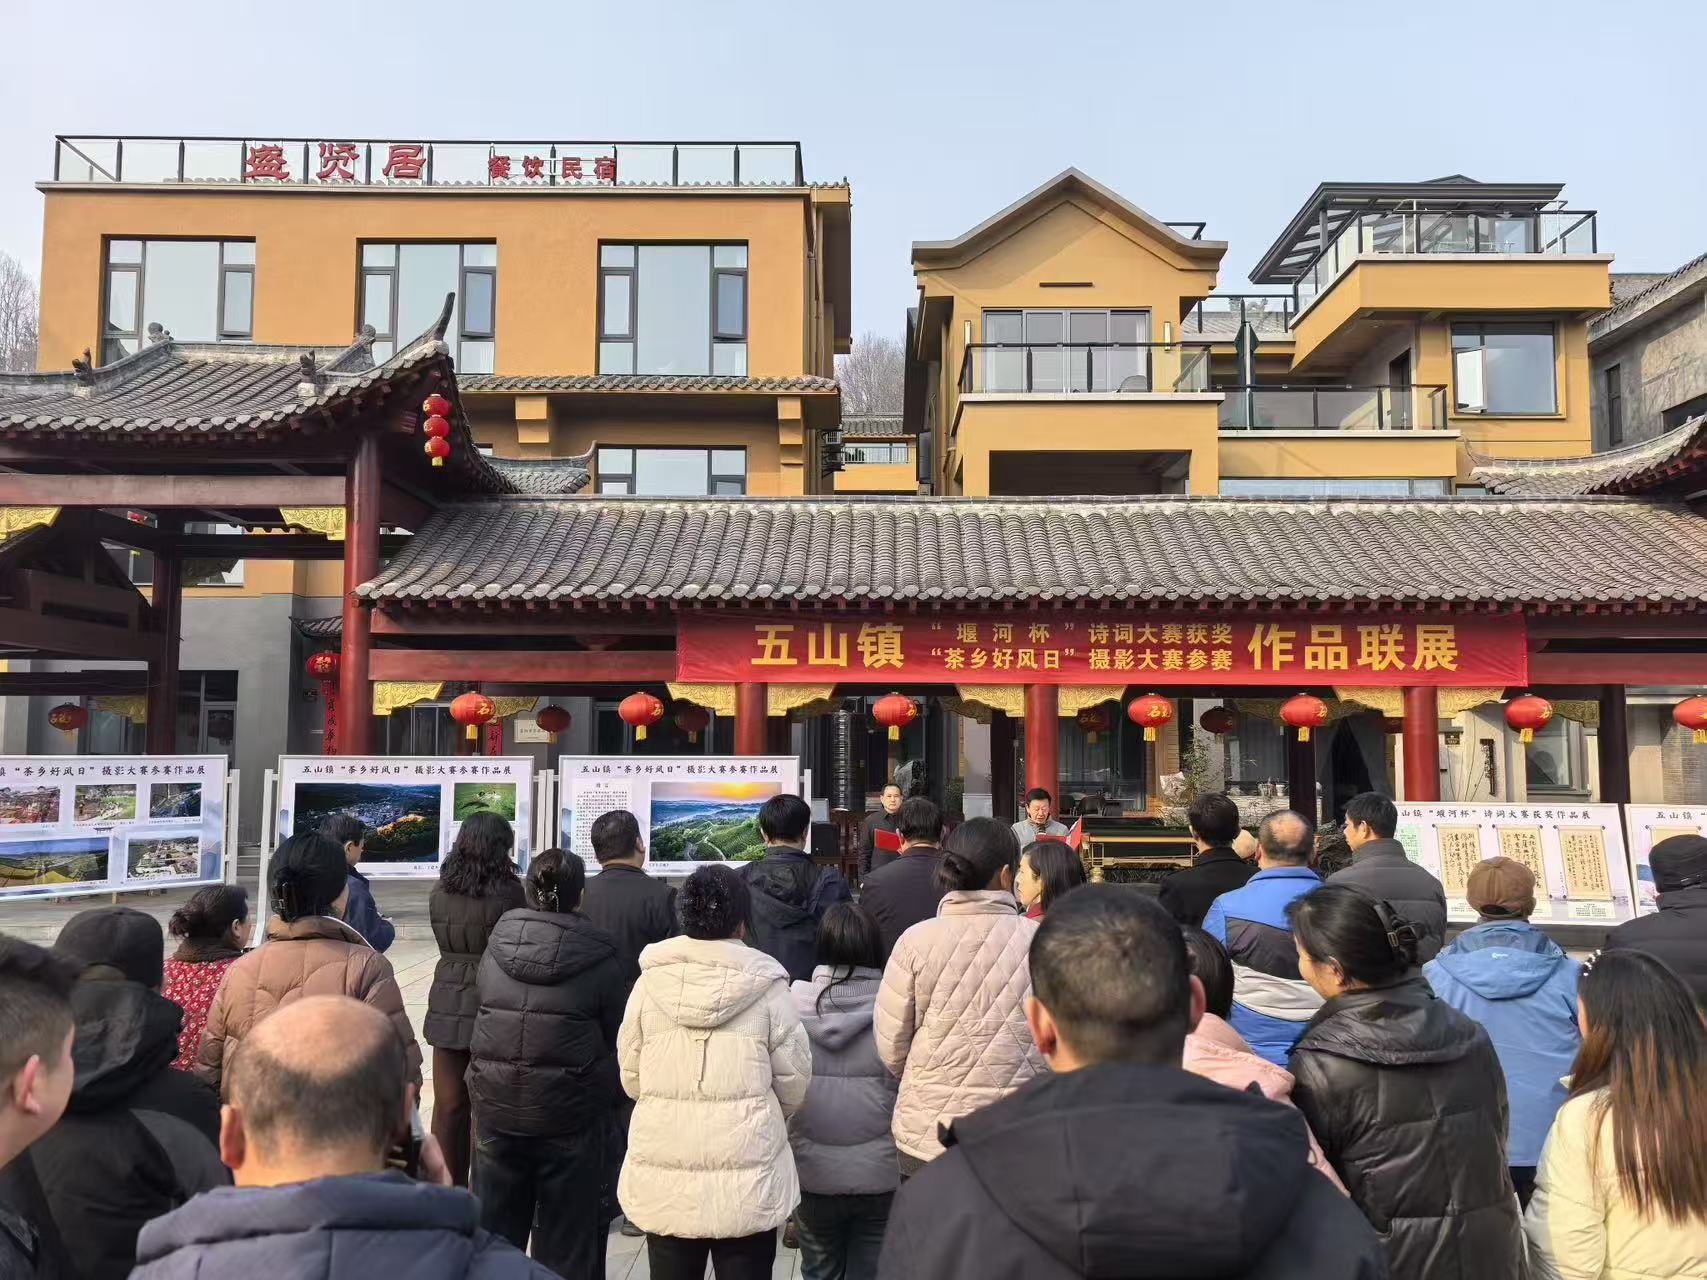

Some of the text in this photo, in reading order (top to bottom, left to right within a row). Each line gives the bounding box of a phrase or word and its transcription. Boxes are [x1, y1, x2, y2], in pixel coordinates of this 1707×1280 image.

[242, 143, 616, 180] 盛贤居 餐饮民宿
[751, 622, 904, 669] 五山镇
[1248, 623, 1459, 671] 作品联展
[1401, 809, 1591, 819] 山镇“堰河杯”诗词大赛获奖作品展
